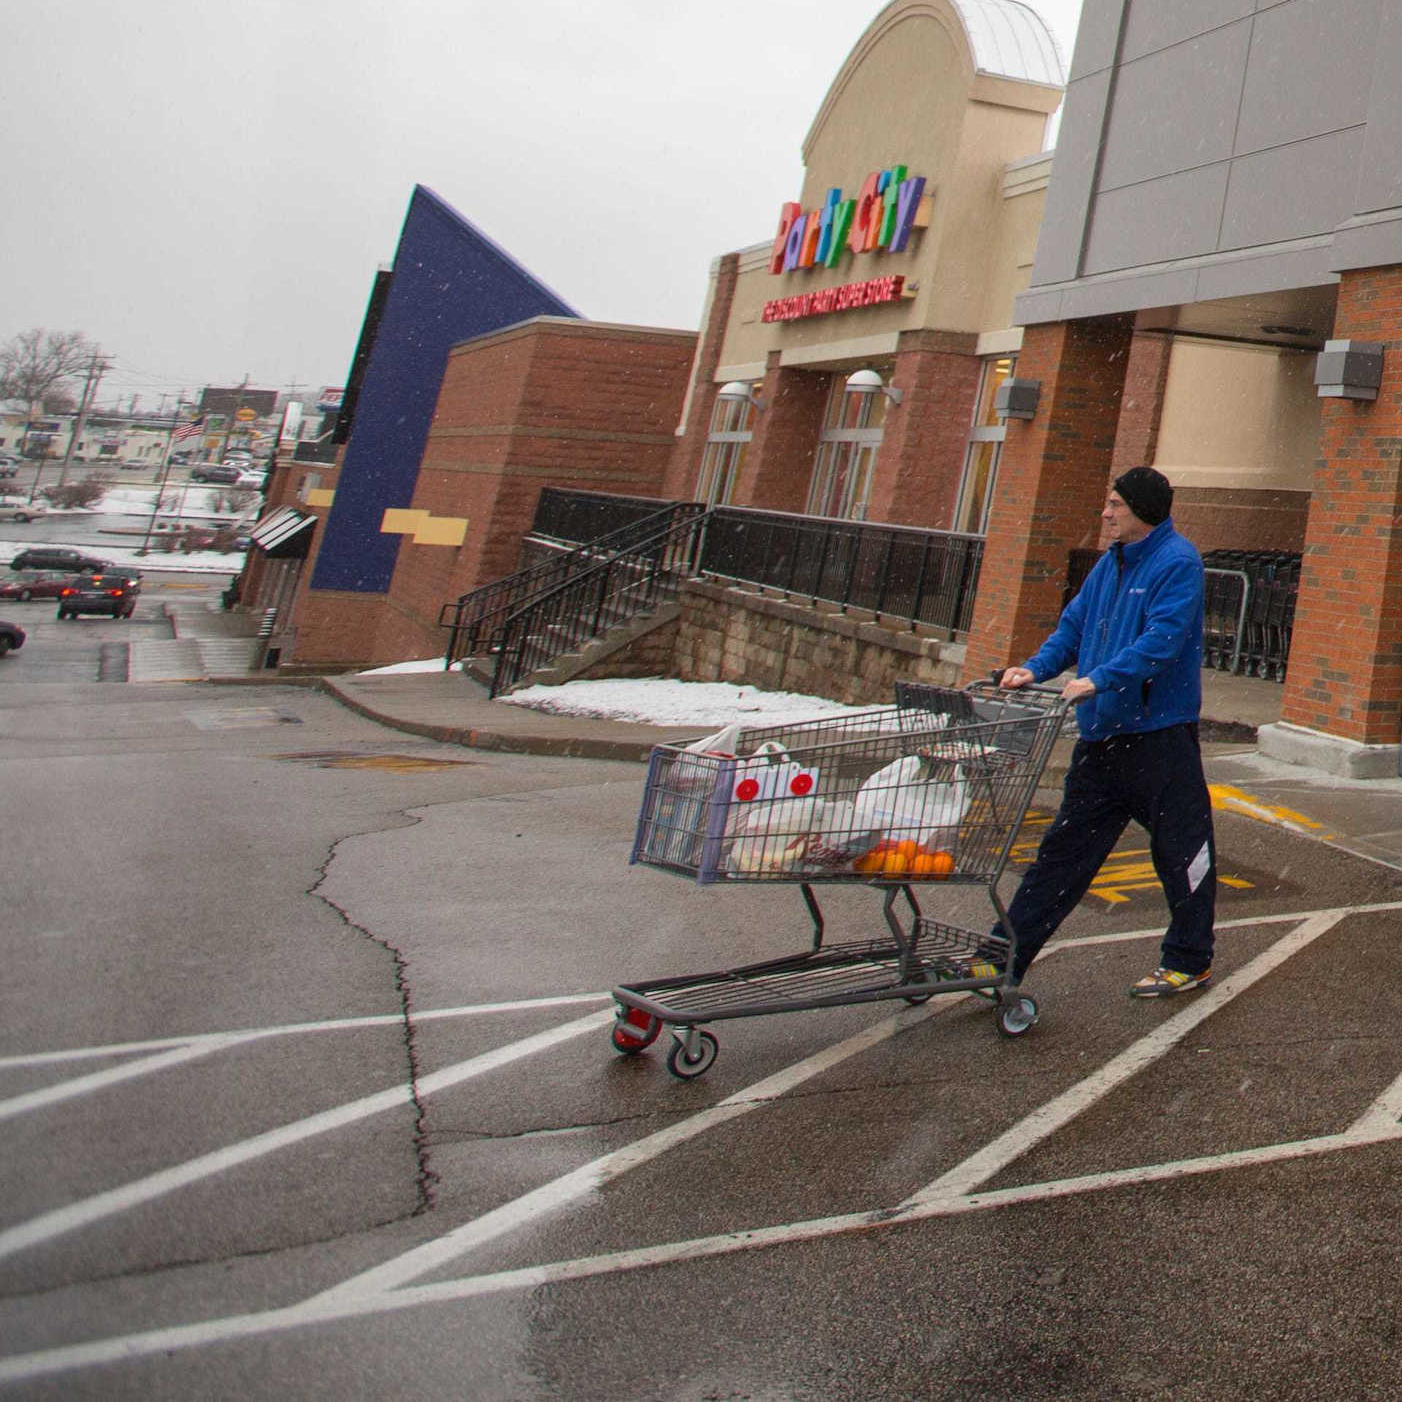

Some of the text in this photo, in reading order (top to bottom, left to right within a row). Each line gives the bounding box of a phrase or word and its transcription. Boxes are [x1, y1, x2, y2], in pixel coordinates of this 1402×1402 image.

[768, 165, 927, 275] Party City
[836, 281, 866, 311] SUPER
[864, 275, 903, 306] STORE
